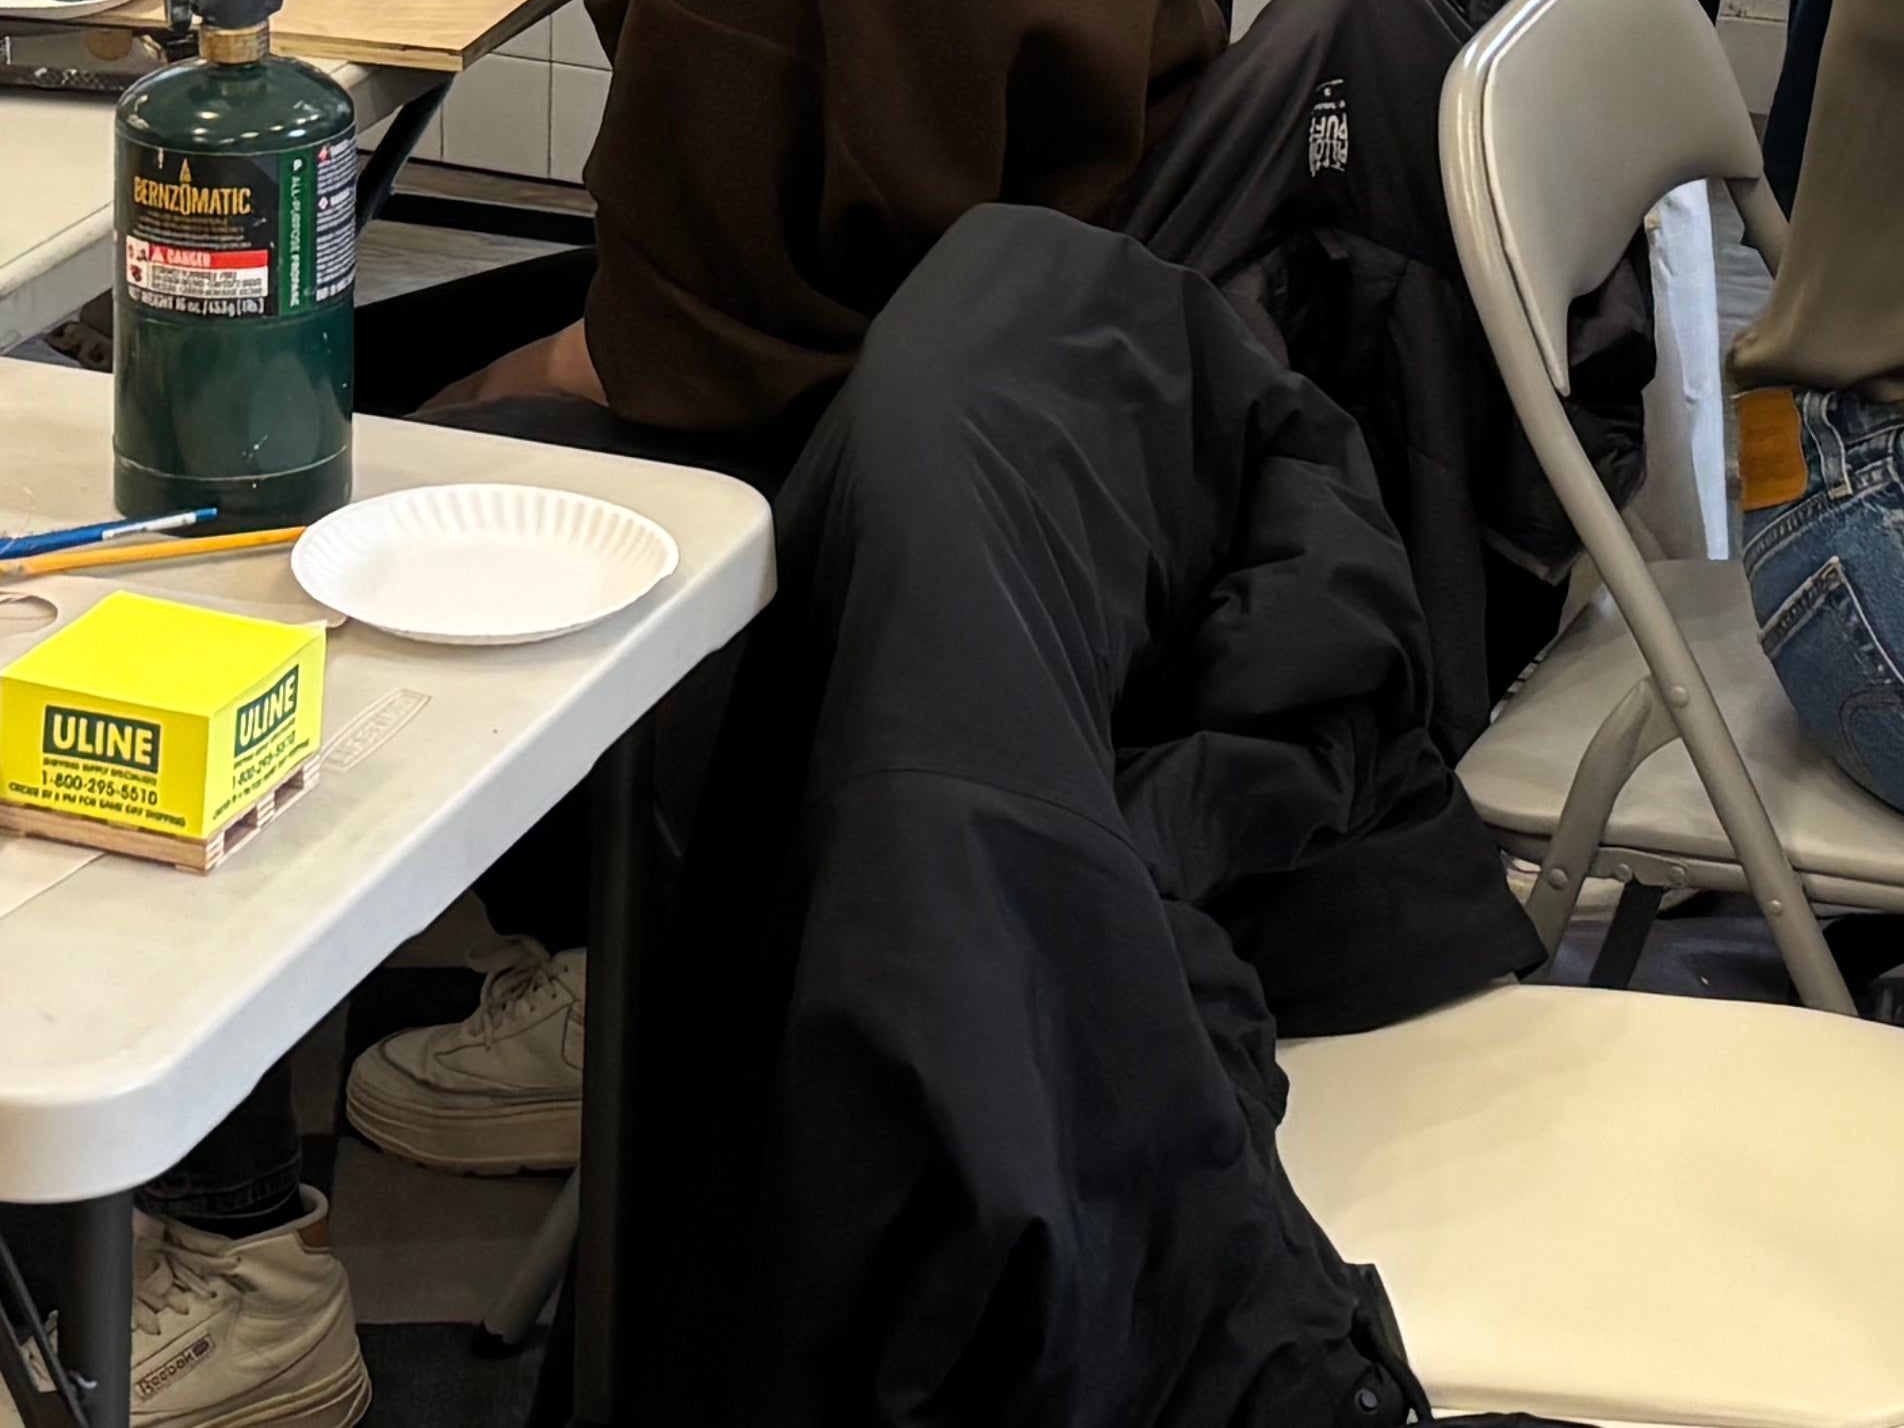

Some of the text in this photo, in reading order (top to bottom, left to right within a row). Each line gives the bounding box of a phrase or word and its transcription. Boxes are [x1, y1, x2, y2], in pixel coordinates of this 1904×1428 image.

[133, 175, 252, 215] BERNZOMATIC
[239, 674, 295, 747] ULINE
[53, 714, 153, 766] ULINE
[42, 770, 158, 806] 1-800-295-5510
